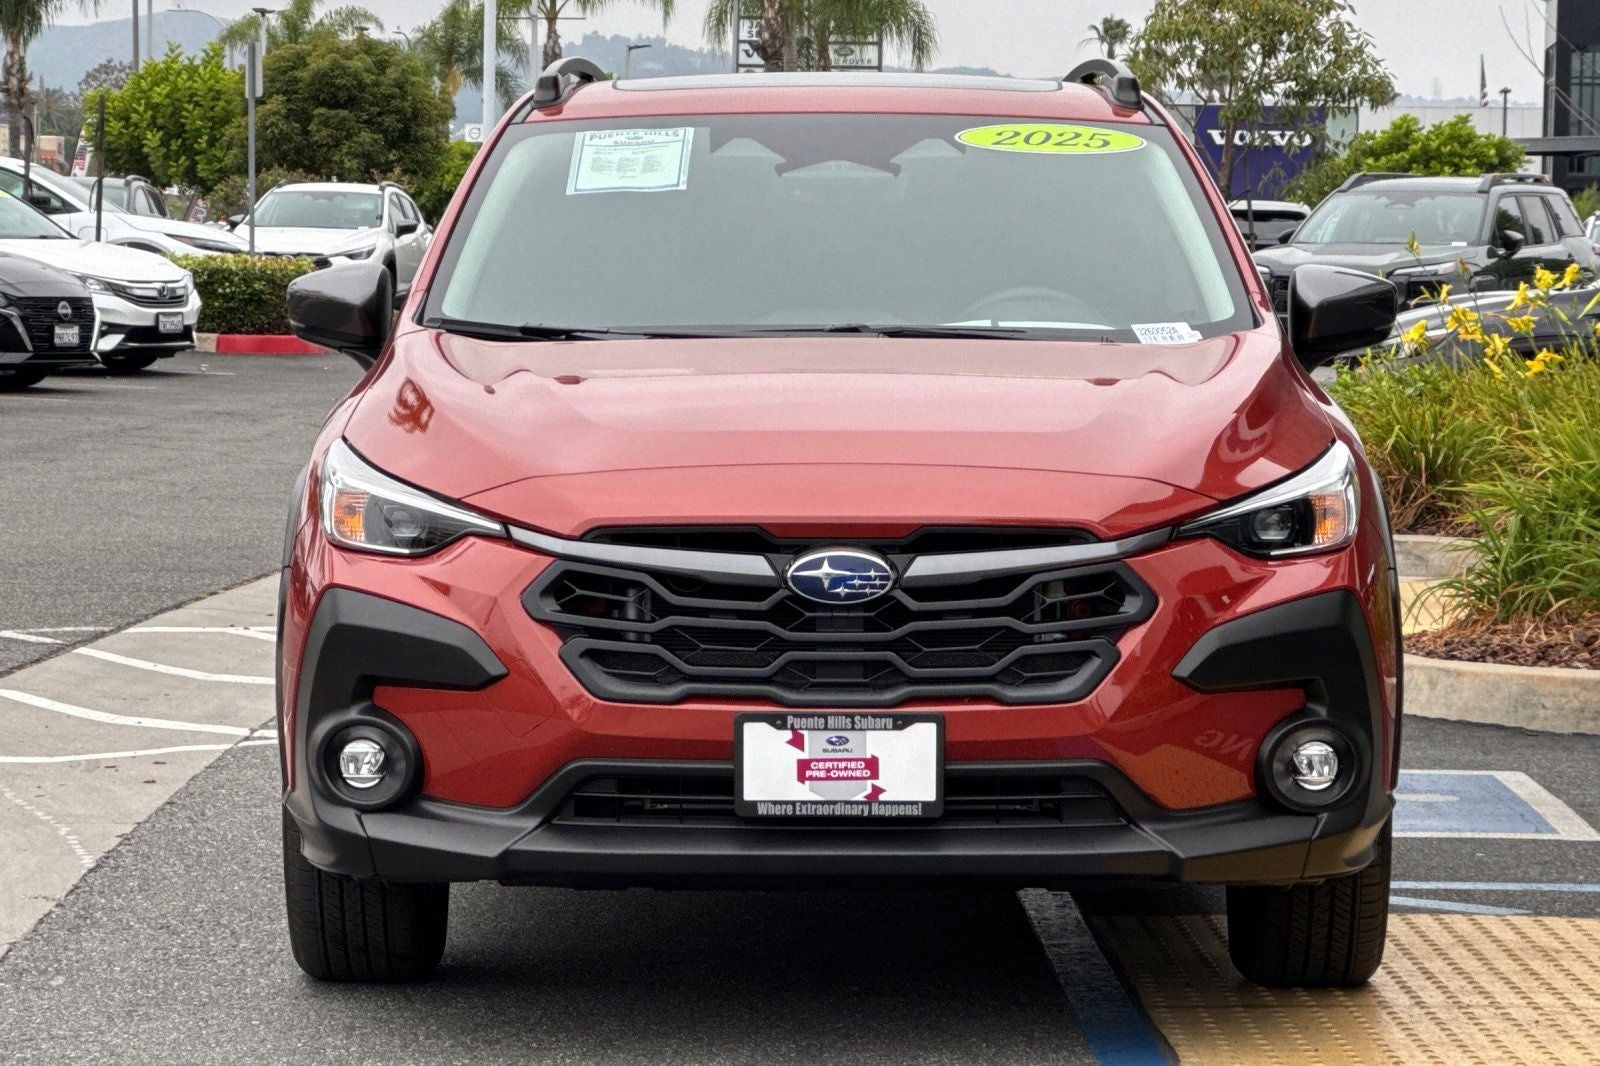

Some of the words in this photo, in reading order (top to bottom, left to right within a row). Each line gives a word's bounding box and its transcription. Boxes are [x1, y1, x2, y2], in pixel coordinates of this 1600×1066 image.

[991, 130, 1113, 149] 2025
[787, 715, 826, 730] Puente
[827, 715, 852, 730] Hills
[854, 715, 893, 730] Subaru
[810, 761, 866, 770] CERTIFIED
[805, 769, 871, 778] PRE-OWNED
[757, 802, 793, 816] Where
[796, 802, 869, 817] Extraordinary
[871, 802, 922, 817] Happens!
